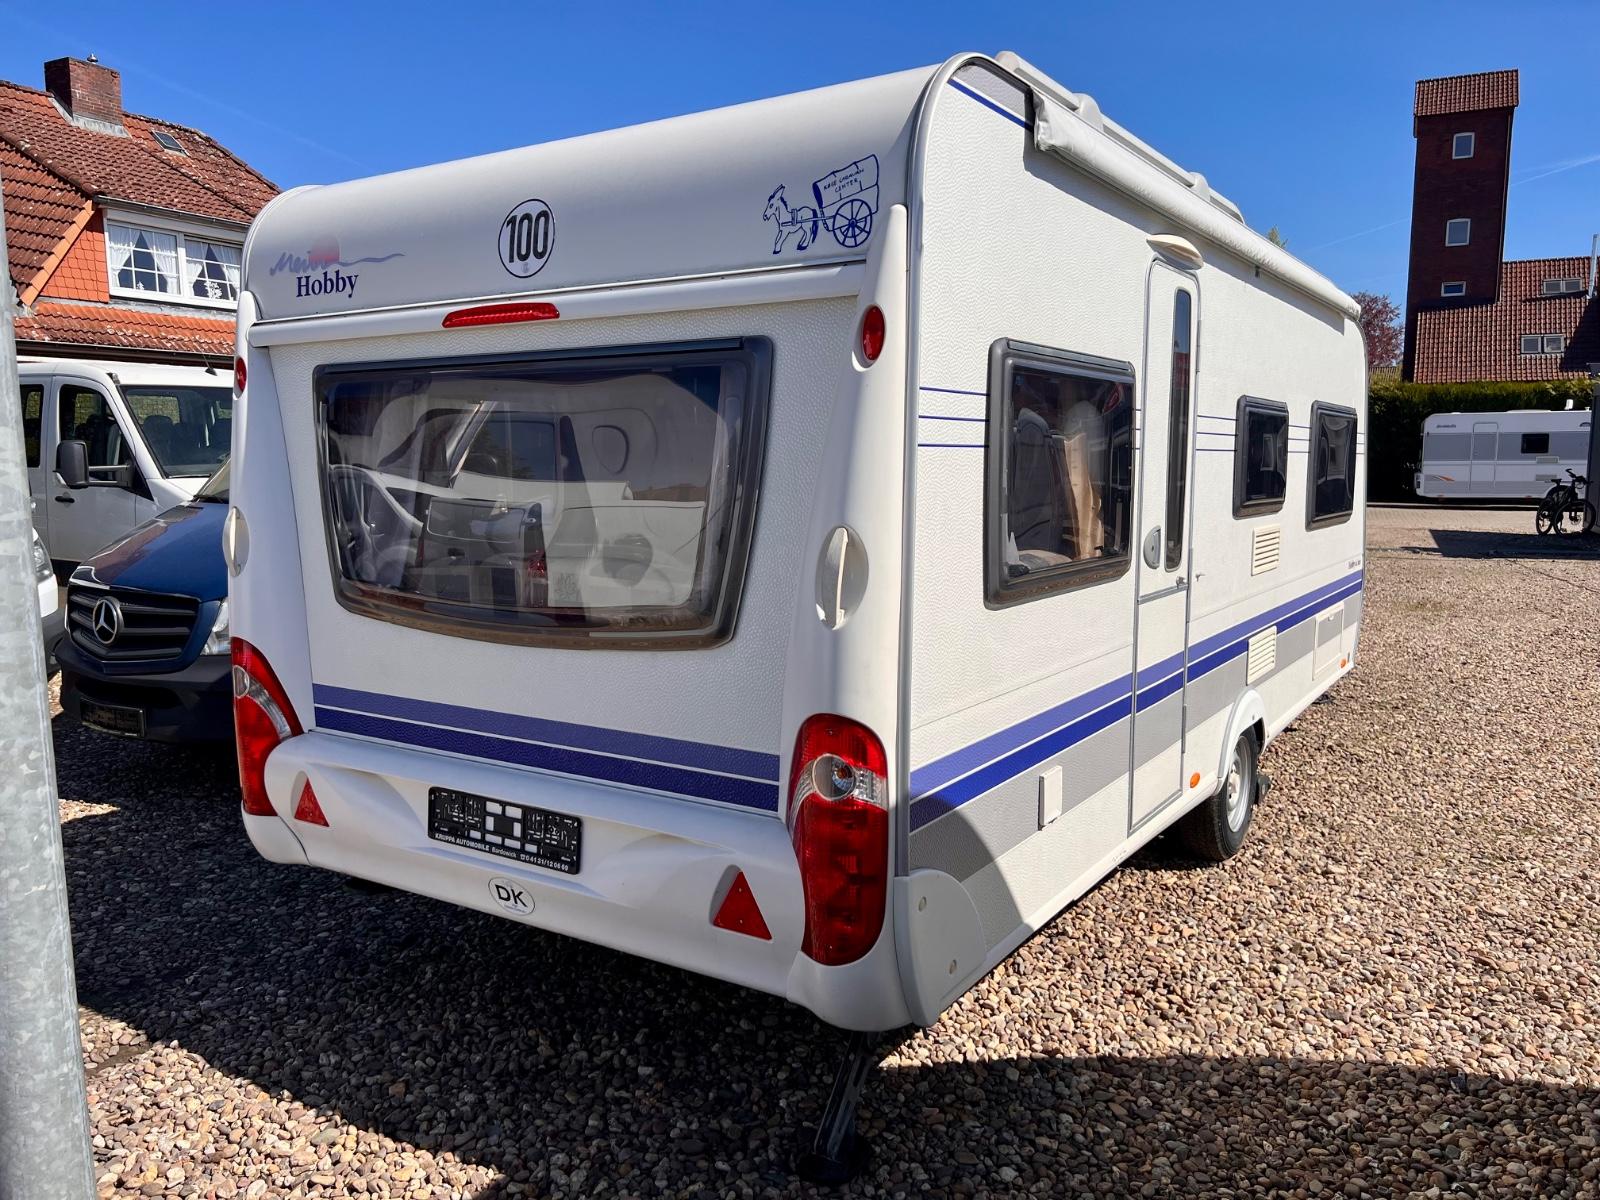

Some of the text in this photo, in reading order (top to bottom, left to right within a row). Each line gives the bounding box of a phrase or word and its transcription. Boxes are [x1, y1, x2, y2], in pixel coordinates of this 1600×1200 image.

[506, 210, 550, 263] 100
[296, 269, 359, 298] Hobby
[456, 838, 490, 851] AUTOMOBILE
[494, 884, 528, 908] DK
